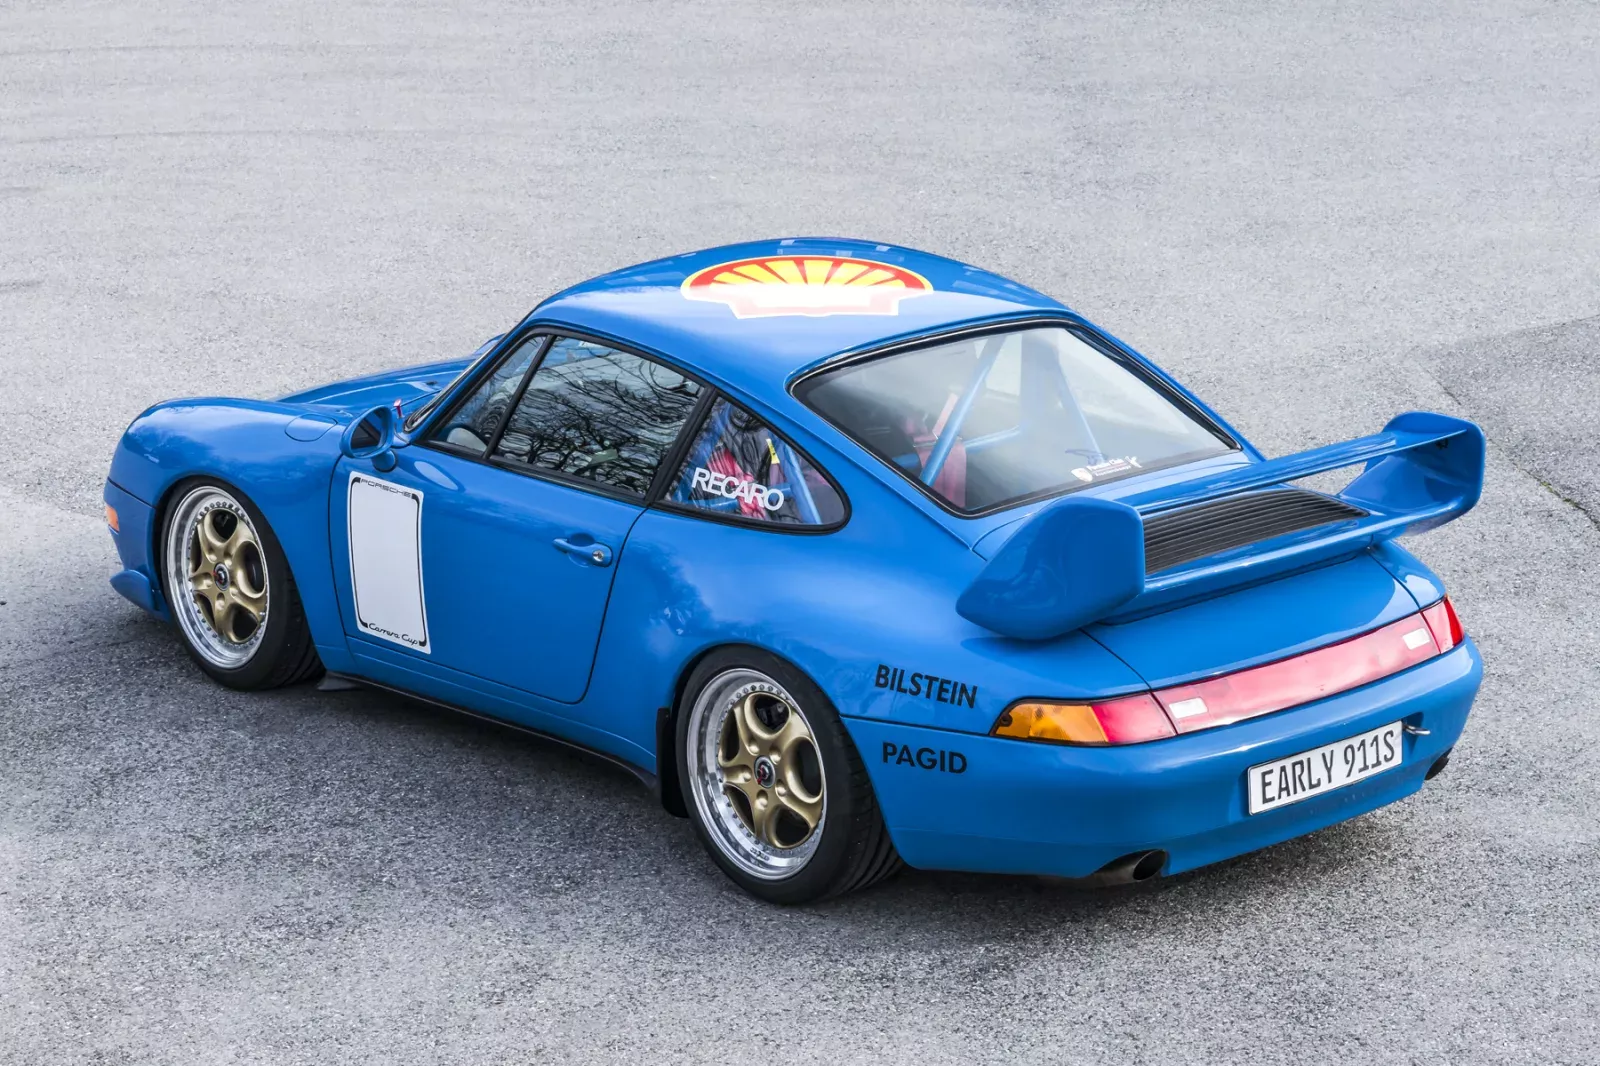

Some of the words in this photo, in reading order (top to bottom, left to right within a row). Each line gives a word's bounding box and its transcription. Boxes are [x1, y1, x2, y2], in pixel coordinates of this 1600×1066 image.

[361, 478, 411, 498] PORSCHE
[692, 467, 785, 511] RECARO
[369, 622, 400, 639] Carrera
[401, 633, 419, 646] Cup
[875, 663, 978, 709] BILSTEIN
[882, 741, 968, 774] PAGID
[1261, 749, 1335, 805] EARLY
[1343, 729, 1396, 778] 911S
